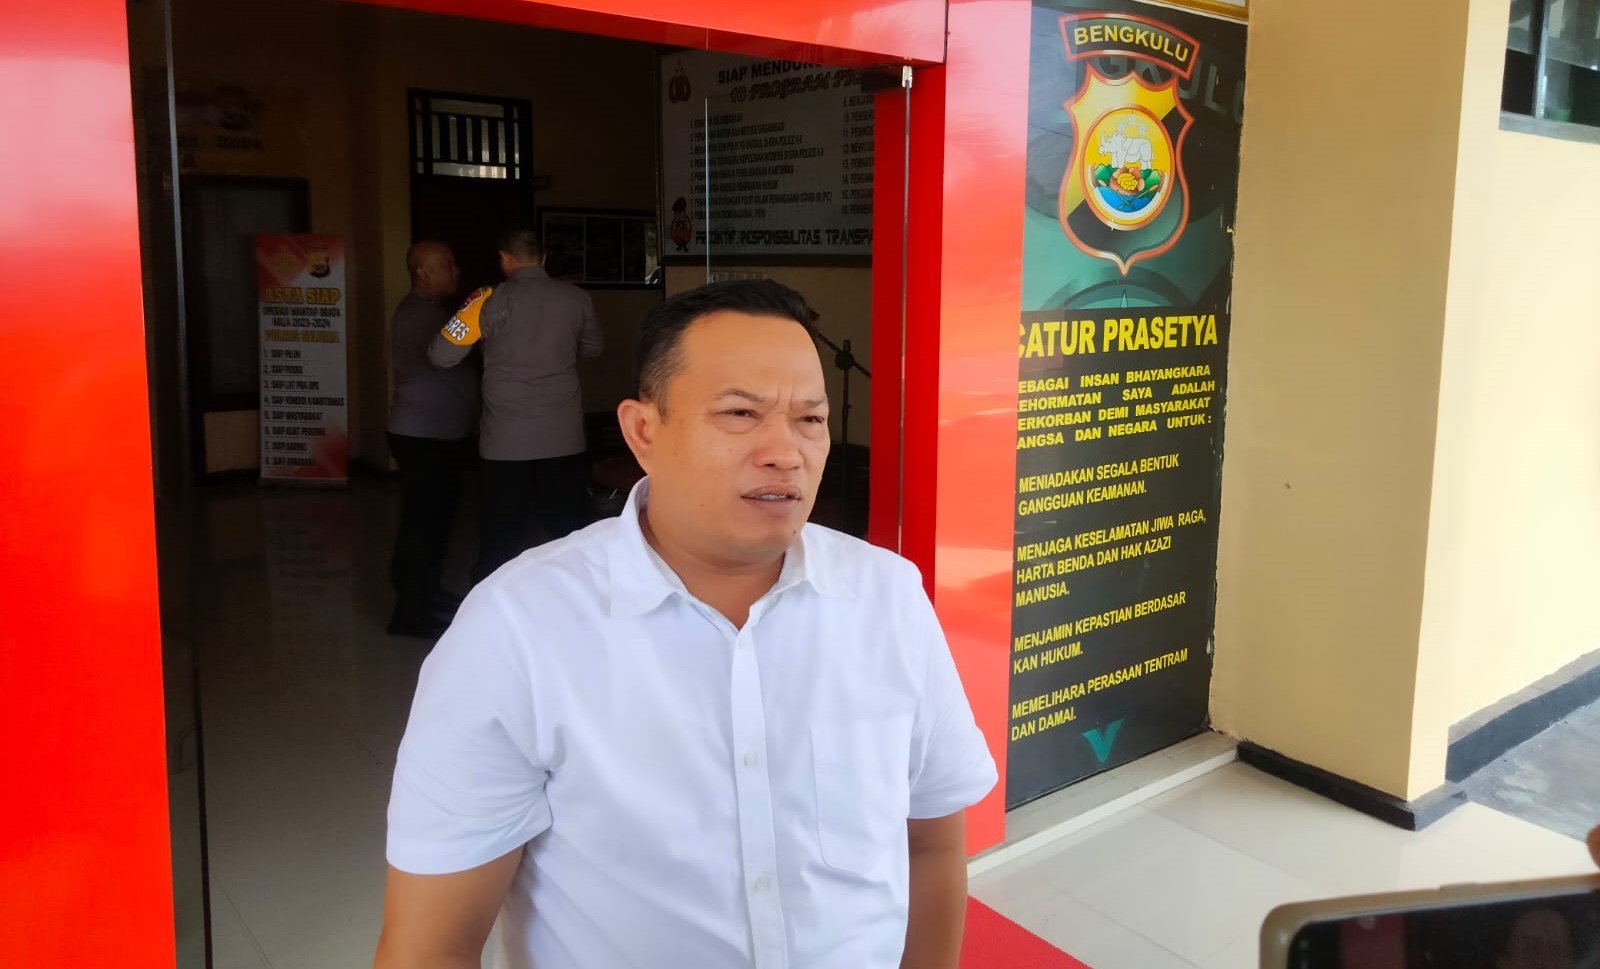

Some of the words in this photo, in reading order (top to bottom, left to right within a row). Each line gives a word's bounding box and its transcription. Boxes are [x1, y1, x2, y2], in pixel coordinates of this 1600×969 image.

[1073, 25, 1188, 62] BENGKULU
[718, 67, 747, 84] SIAP
[306, 287, 341, 305] SIAP
[1103, 315, 1218, 352] PRASETYA
[1017, 392, 1102, 413] EHORMATAN
[1122, 386, 1153, 401] SAYA
[1171, 380, 1215, 396] ADALAH
[1018, 377, 1069, 394] EBAGAI
[1080, 372, 1120, 388] INSAN
[1126, 365, 1211, 383] BHAYANGKARA
[1017, 411, 1091, 431] ERKORBAN
[1099, 406, 1129, 421] DEMI
[1135, 397, 1211, 417] MASYARAKAT
[1016, 433, 1064, 450] ANGSA
[1075, 427, 1101, 442] DAN
[1108, 420, 1157, 437] NEGARA
[1019, 467, 1094, 494] MENIADAKAN
[1096, 461, 1138, 481] SEGALA
[1140, 453, 1180, 473] BENTUK
[1018, 493, 1084, 516] GANGGUAN
[1087, 480, 1147, 504] KEAMANAN.
[1017, 536, 1072, 562] MENJAGA
[1074, 520, 1149, 550] KESELAMATAN
[1151, 515, 1174, 532] JIWA
[1178, 509, 1207, 527] RAGA,
[1016, 565, 1055, 585] HARTA
[1057, 554, 1094, 576] BENDA
[1097, 548, 1119, 566] DAN
[1121, 542, 1142, 560] HAK
[1144, 535, 1171, 556] AZAZI
[1016, 581, 1070, 607] MANUSIA.
[1014, 623, 1073, 652] MENJAMIN
[1075, 606, 1132, 635] KEPASTIAN
[1134, 591, 1186, 618] BERDASAR
[1013, 656, 1038, 675] KAN
[1041, 641, 1083, 667] HUKUM.
[1012, 682, 1085, 720] MEMELIHARA
[1087, 663, 1142, 696] PERASAAN
[1144, 647, 1188, 675] TENTRAM
[1011, 720, 1035, 741] DAN
[1038, 706, 1077, 732] DAMAI.
